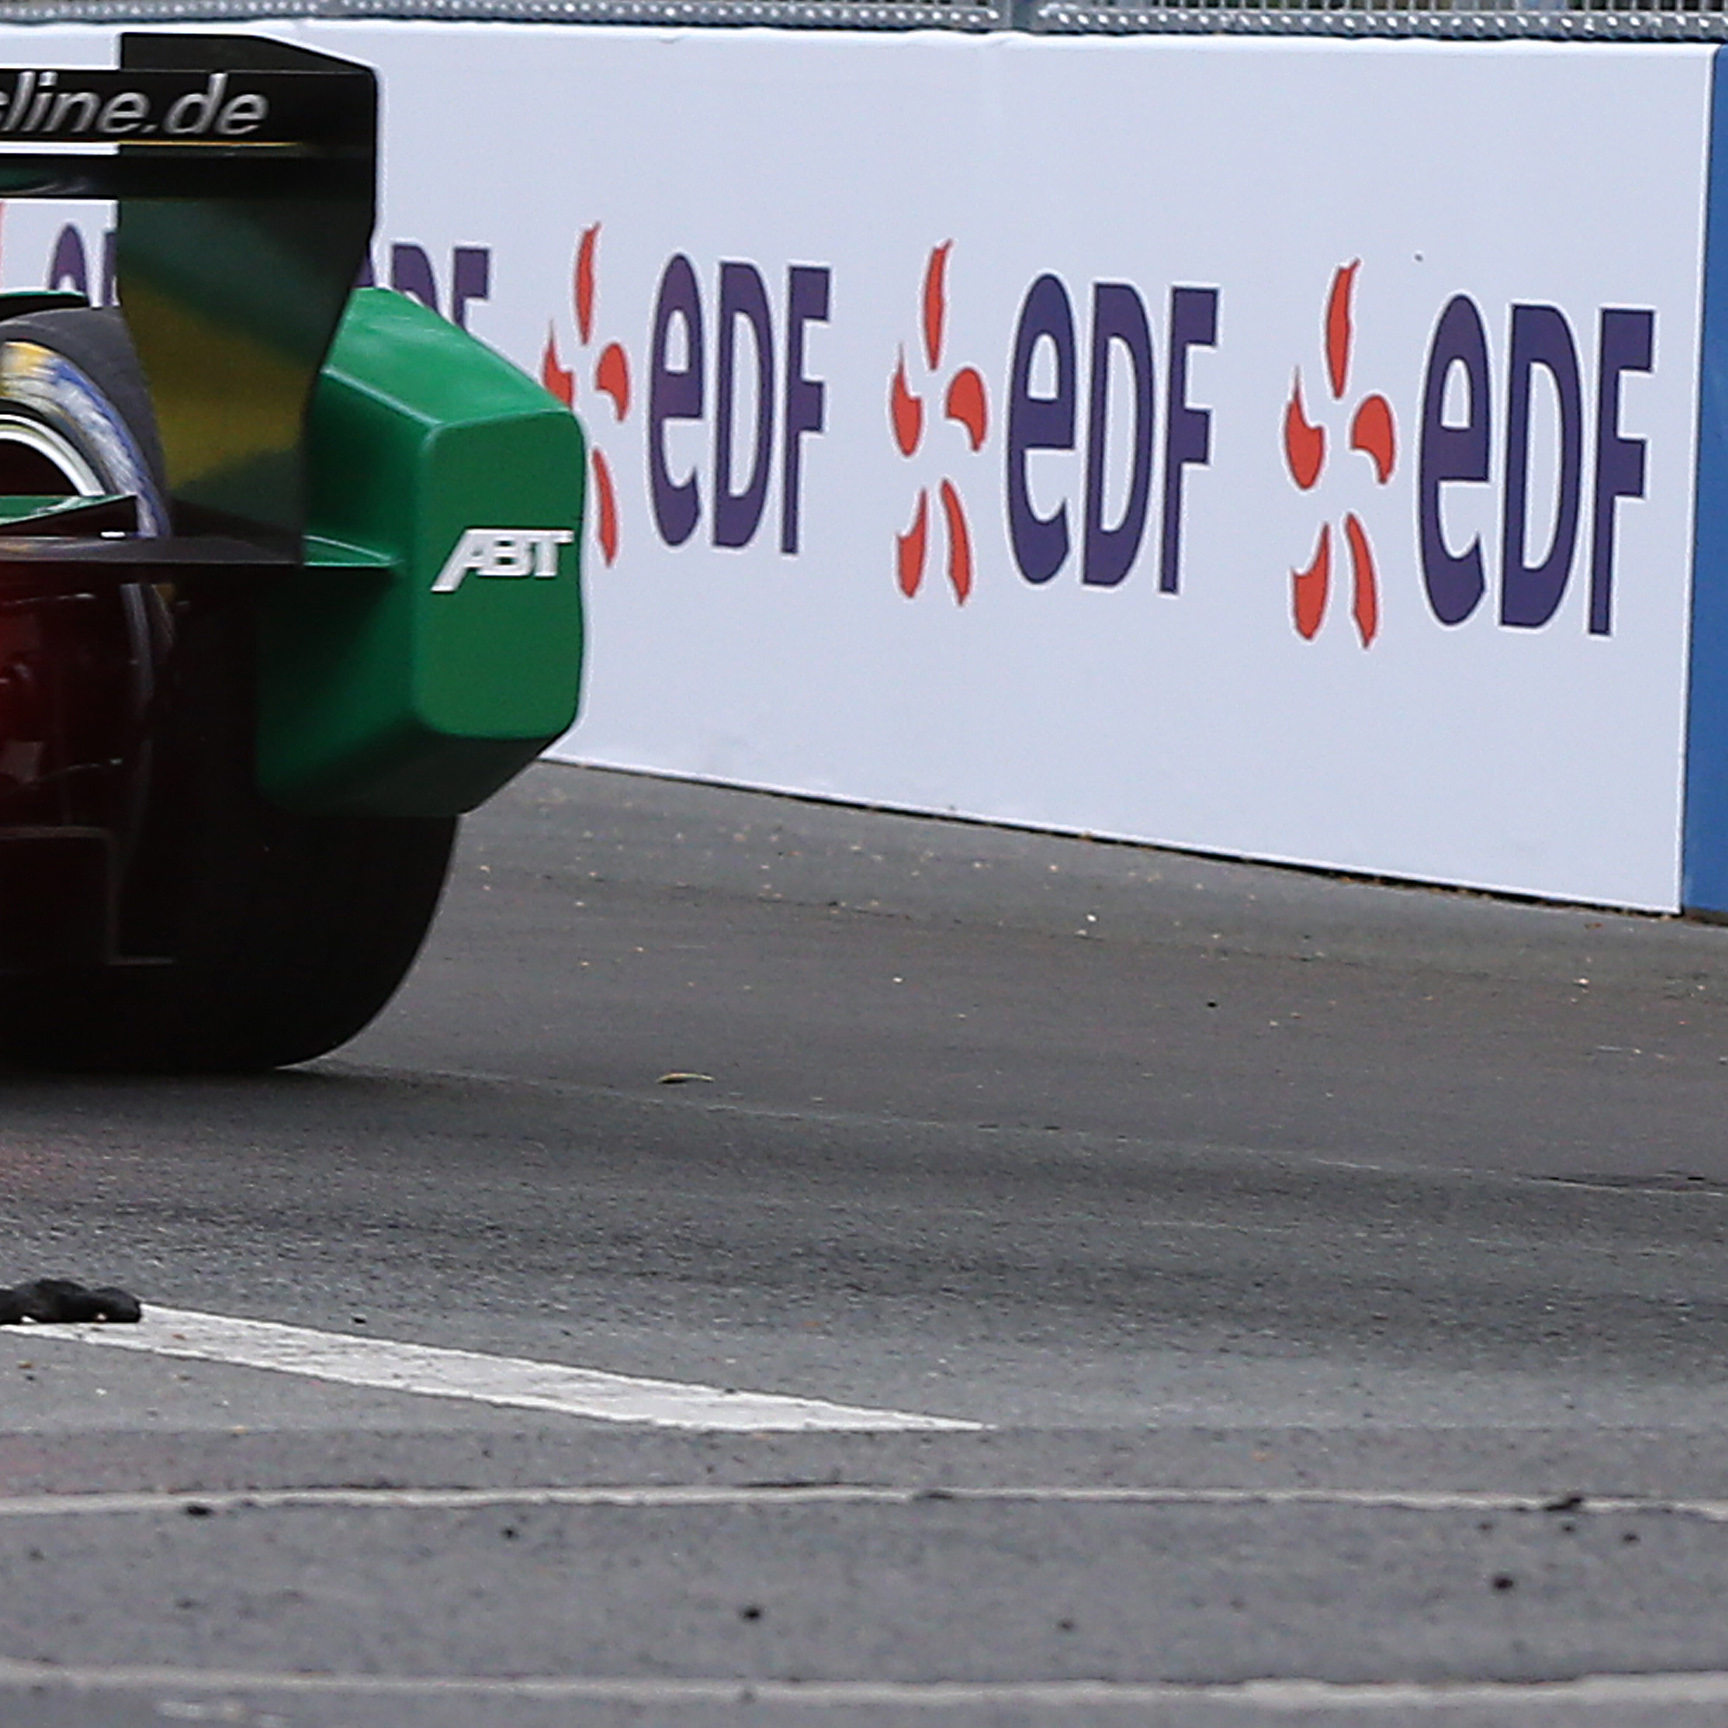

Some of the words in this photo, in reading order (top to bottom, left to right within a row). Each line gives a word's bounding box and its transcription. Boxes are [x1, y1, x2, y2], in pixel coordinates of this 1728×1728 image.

[430, 528, 574, 592] ABT
[648, 253, 831, 555] eDF
[1006, 273, 1219, 595] eDF
[1418, 294, 1655, 636] eDF
